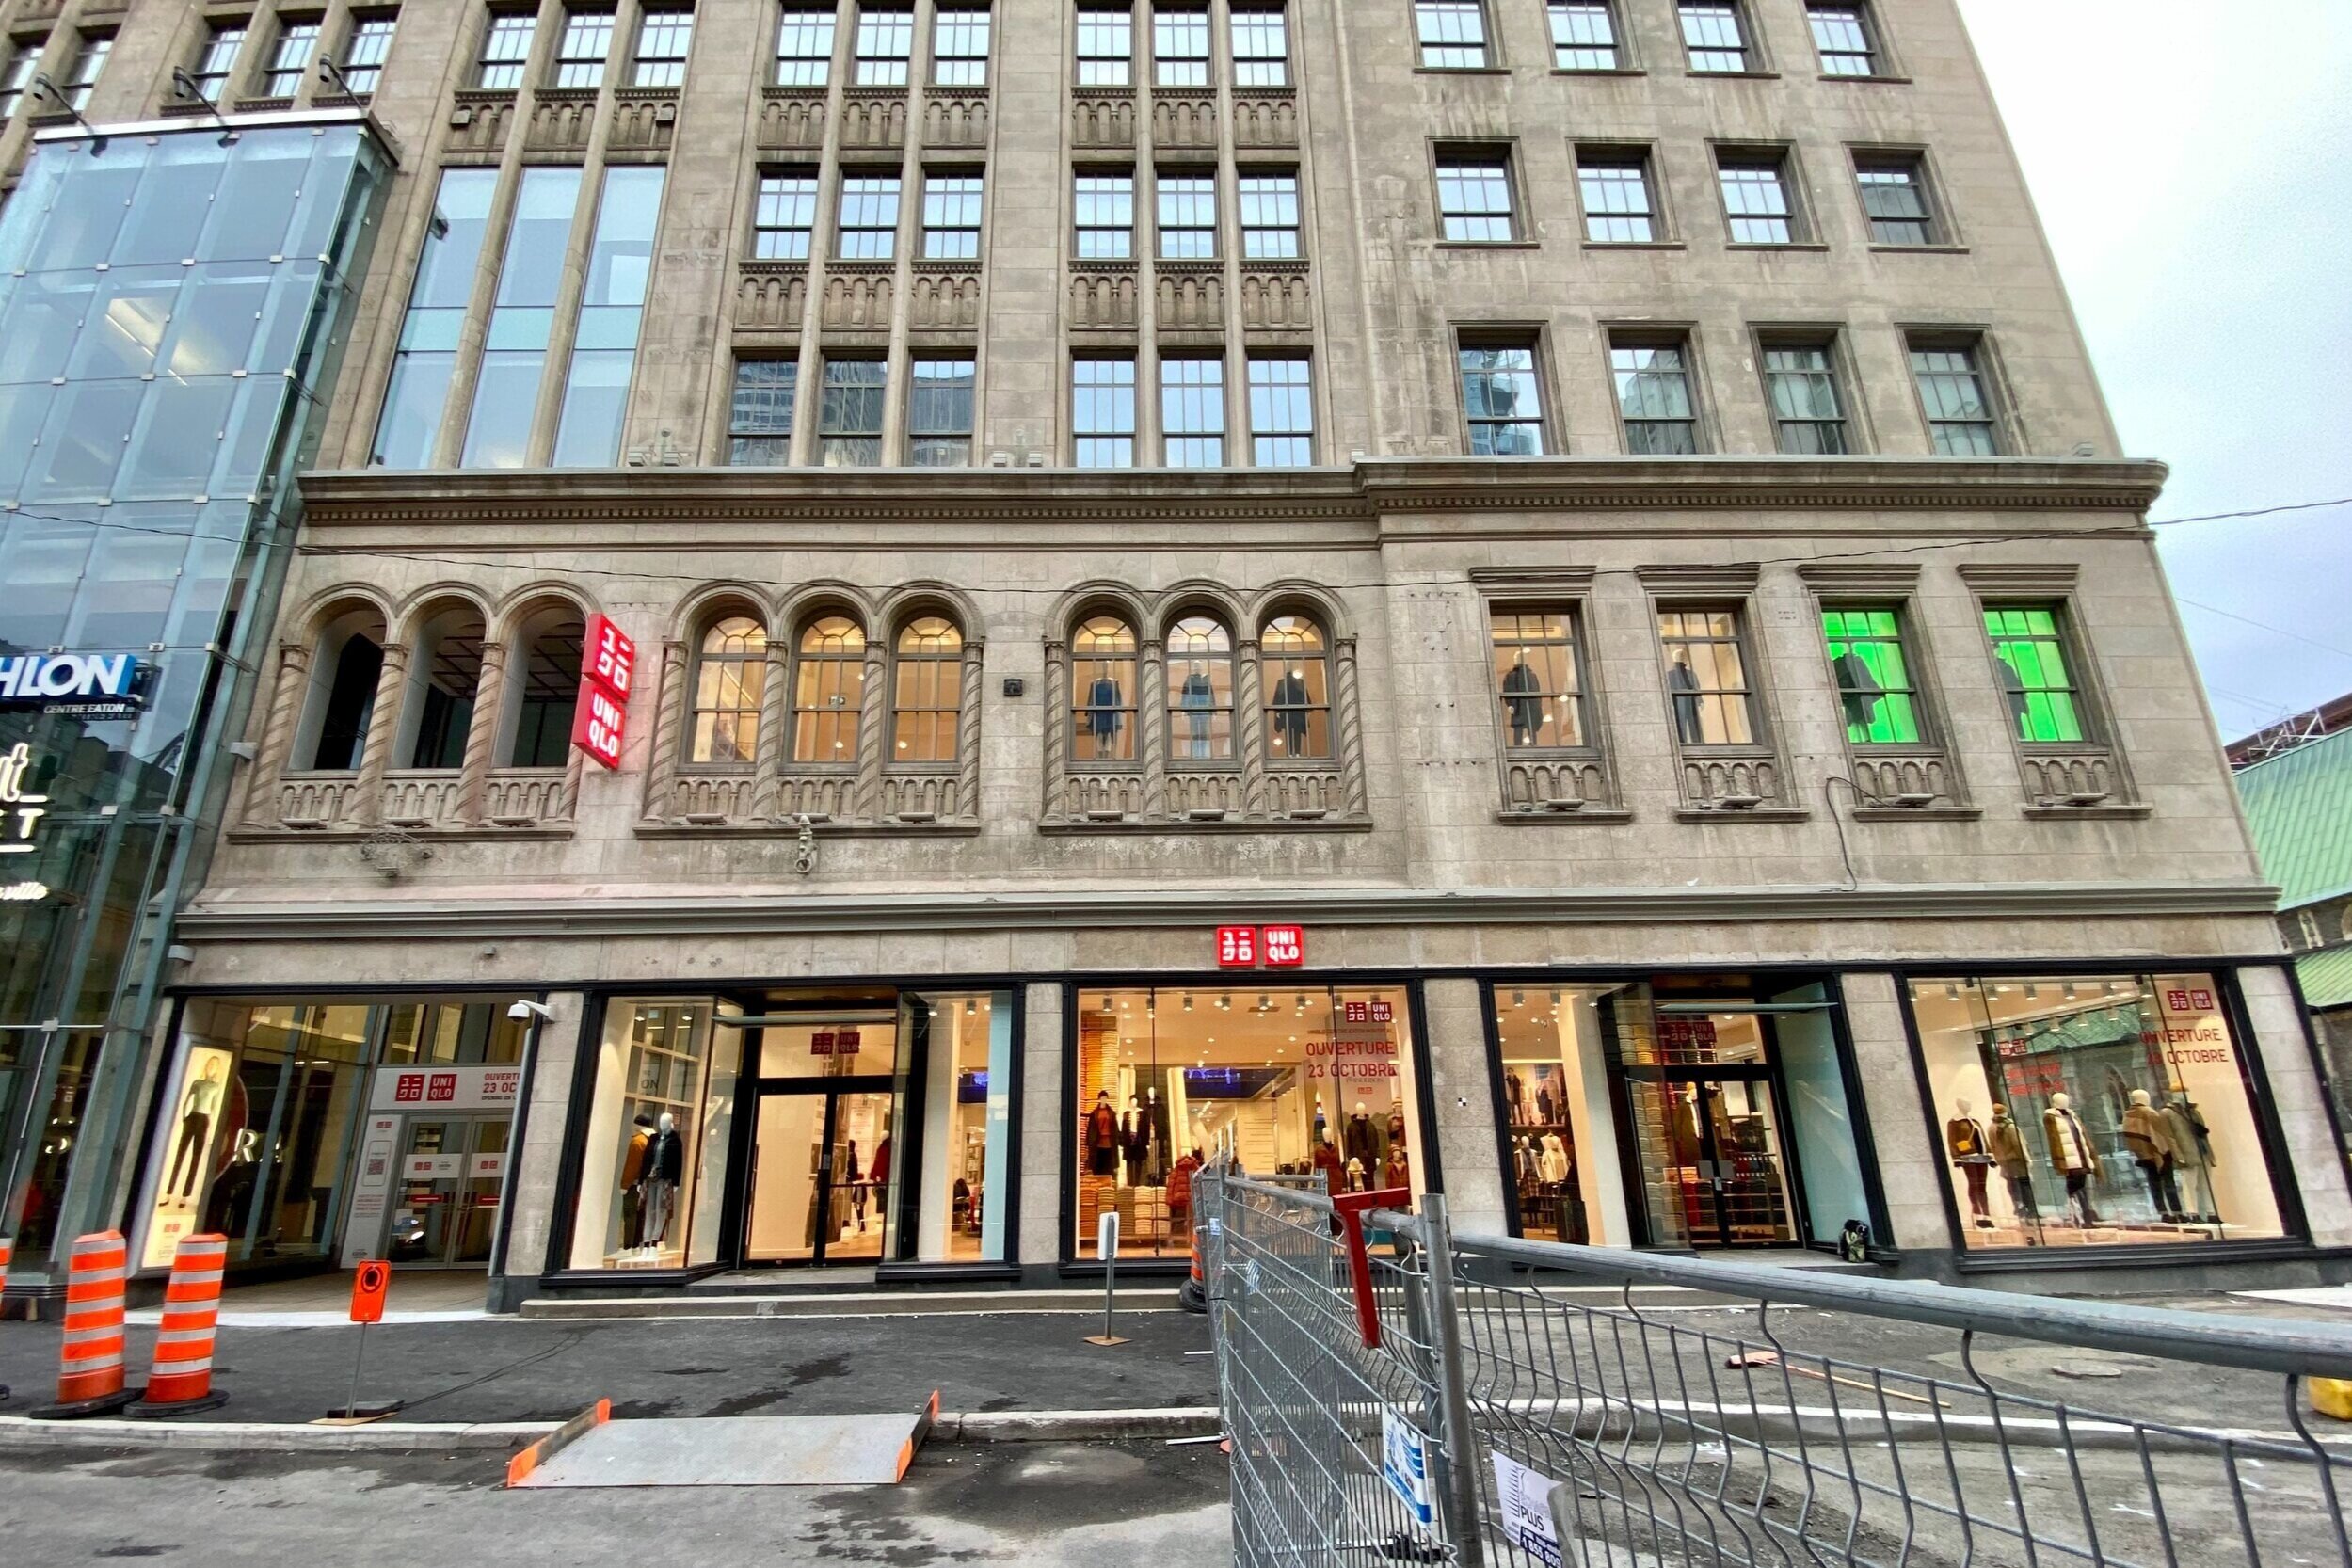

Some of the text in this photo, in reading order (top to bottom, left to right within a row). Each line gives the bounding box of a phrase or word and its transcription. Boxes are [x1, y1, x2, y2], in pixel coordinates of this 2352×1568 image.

[43, 703, 126, 713] CENTRE EATON
[593, 692, 621, 732] UNI
[588, 719, 619, 758] QLO
[1267, 930, 1296, 945] UNI
[1268, 945, 1299, 962] QLO
[1373, 1013, 1391, 1021] QLO
[1305, 1041, 1396, 1056] OUVERTURE
[2167, 1049, 2229, 1064] OCTOBRE
[1308, 1064, 1325, 1078] 23
[432, 1077, 453, 1087] UNI
[483, 1082, 497, 1093] 23
[430, 1088, 453, 1099] QLO
[1520, 1505, 1544, 1532] PLUS
